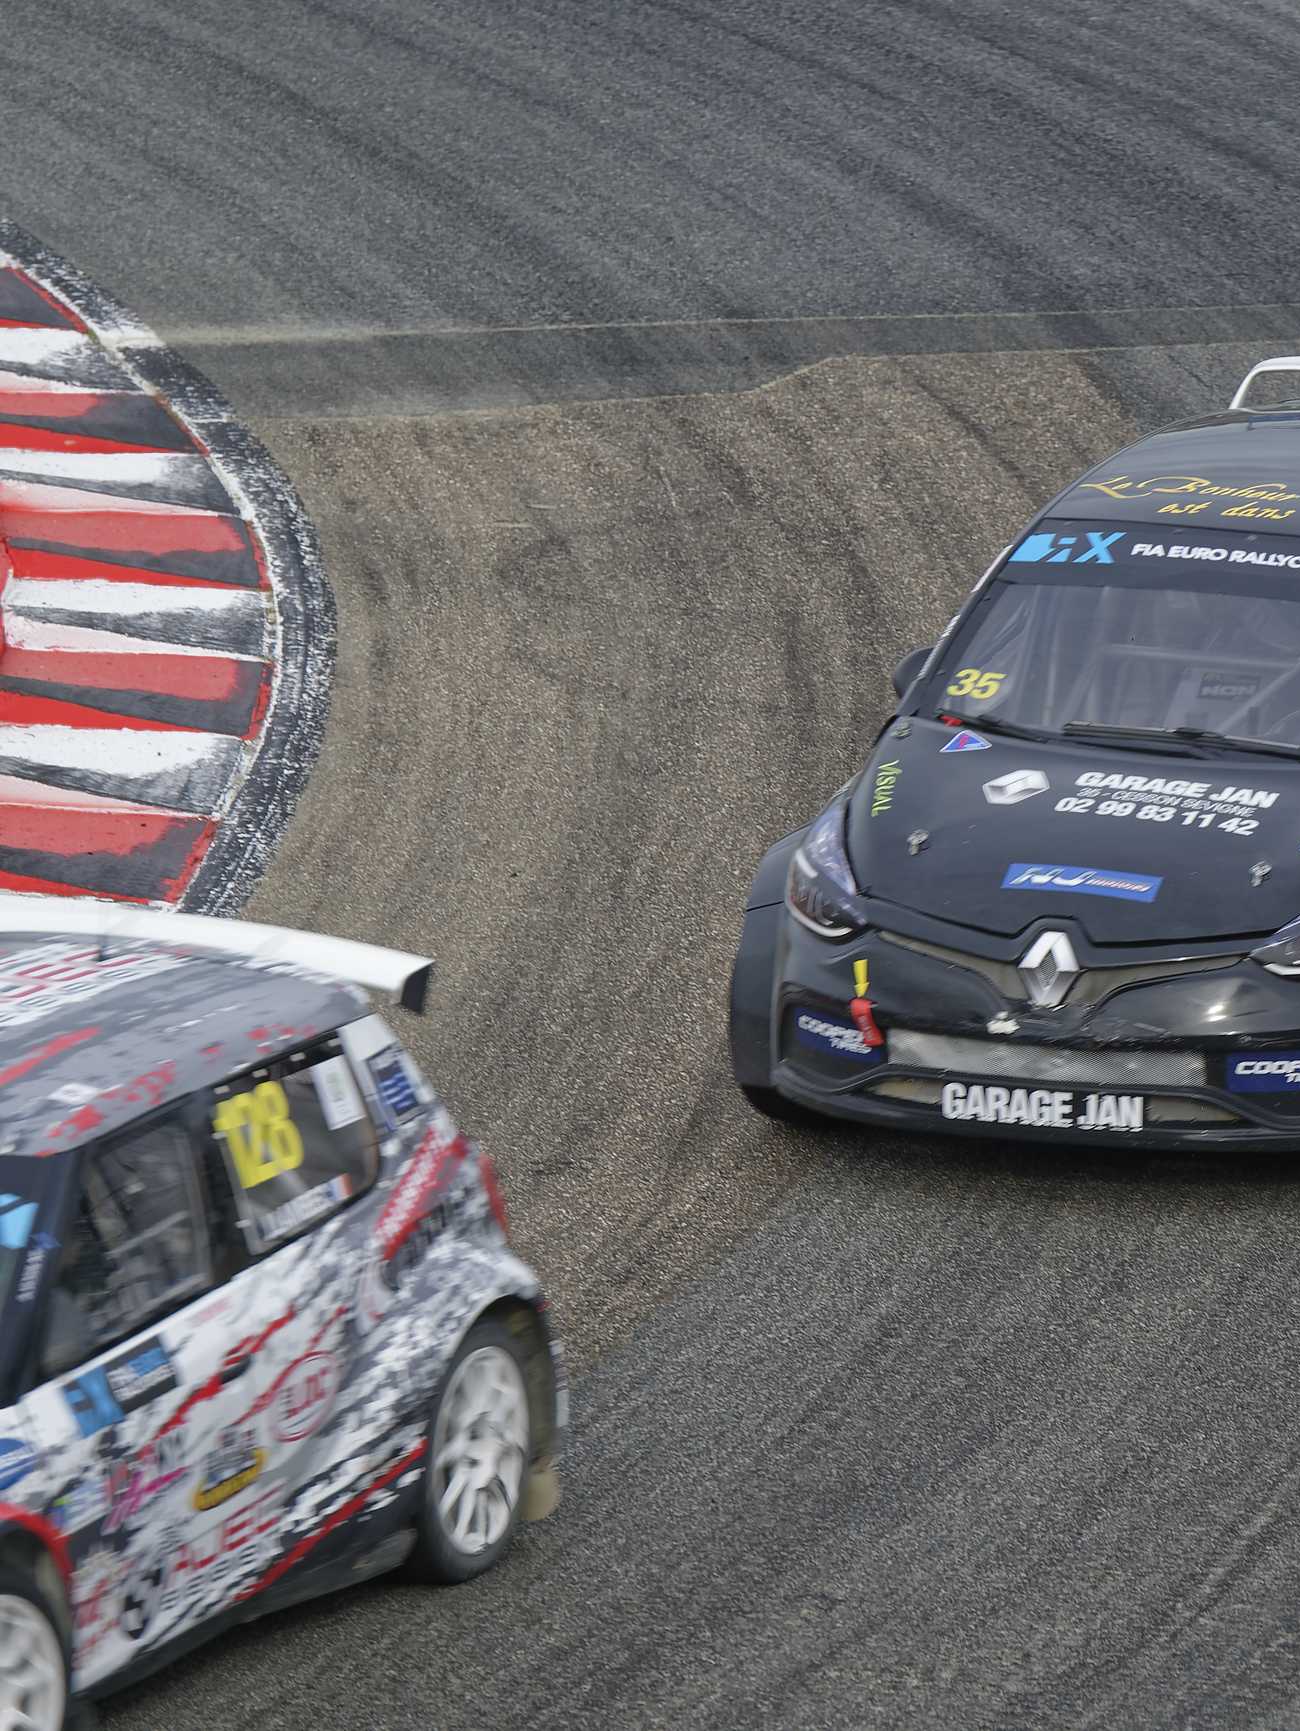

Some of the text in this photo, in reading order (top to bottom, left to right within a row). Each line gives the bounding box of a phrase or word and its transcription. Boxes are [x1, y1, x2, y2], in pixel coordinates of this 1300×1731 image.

[1079, 475, 1153, 500] Le
[1156, 500, 1215, 515] est
[1219, 501, 1297, 520] dans
[1131, 543, 1165, 558] FIA
[1167, 545, 1229, 562] EURO
[946, 668, 1007, 700] 35
[1074, 771, 1281, 809] GARAGE JAN
[1054, 796, 1260, 836] 02 99 83 11 42
[941, 1082, 1144, 1132] GARAGE JAN
[212, 1080, 304, 1189] 128
